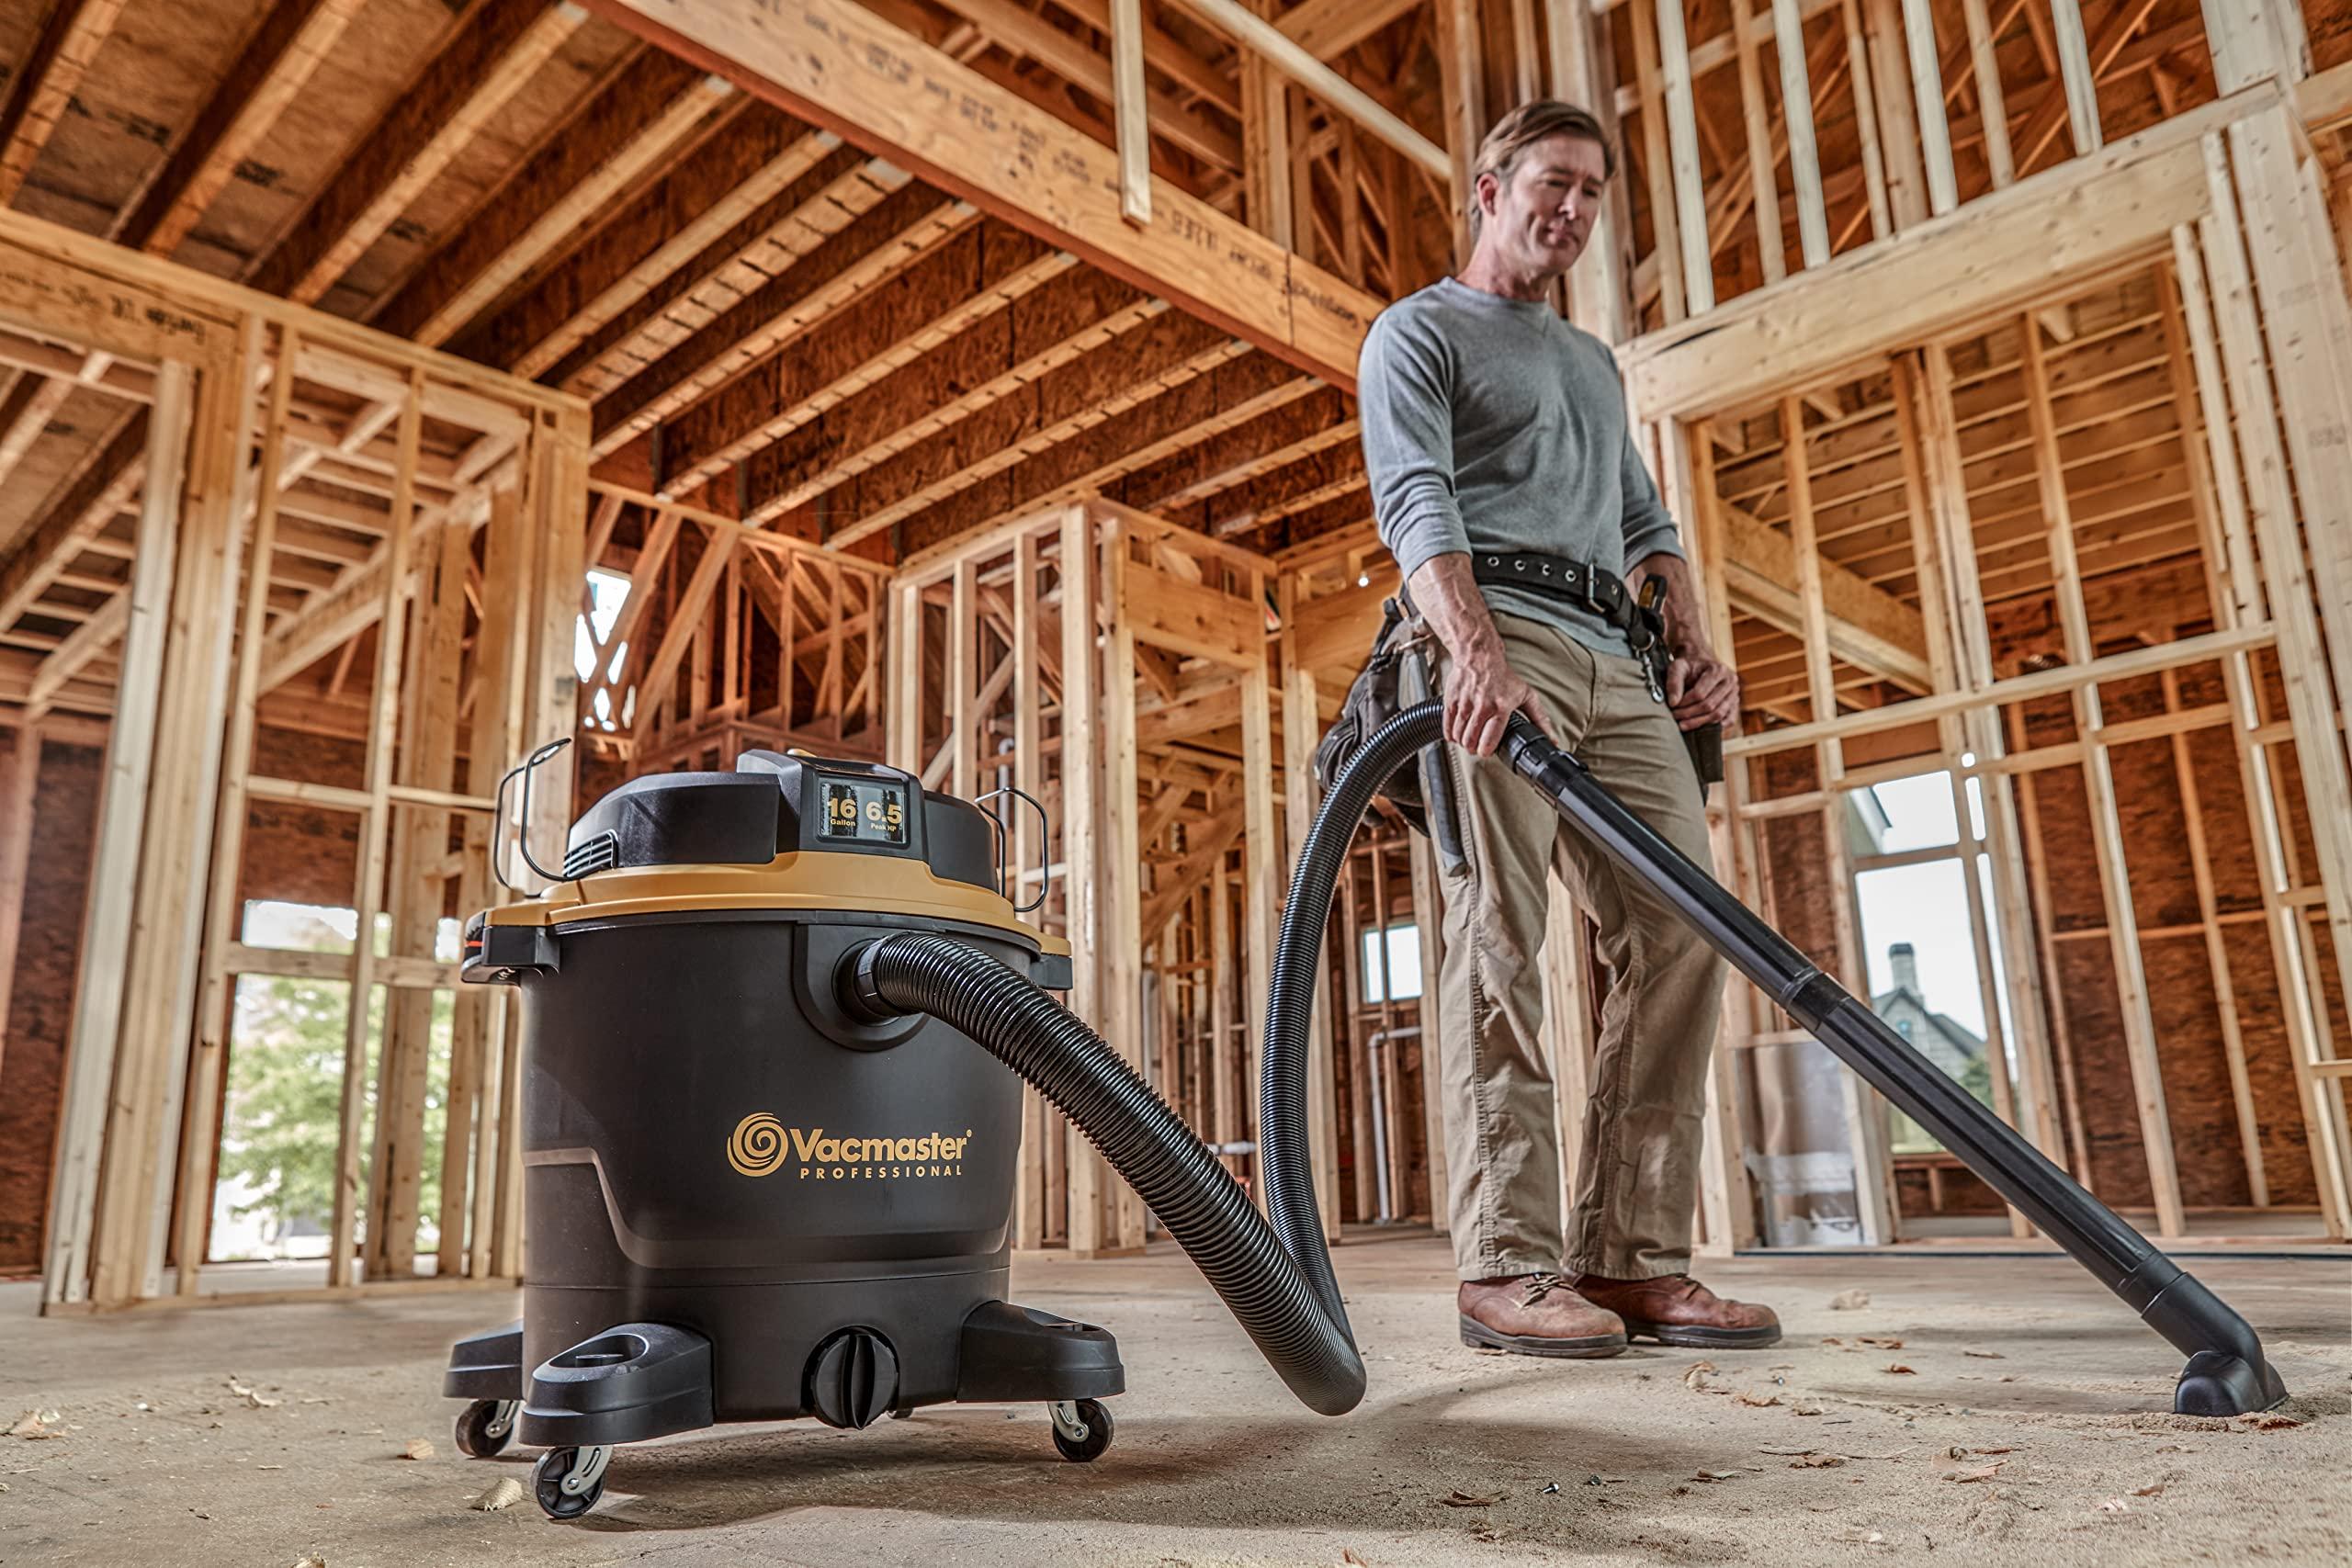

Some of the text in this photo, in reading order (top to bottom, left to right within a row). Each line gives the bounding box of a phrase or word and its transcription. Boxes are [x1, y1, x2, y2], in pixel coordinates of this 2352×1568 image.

[827, 797, 856, 818] 16
[866, 801, 902, 824] 6.5
[830, 818, 856, 827] Gallon
[871, 822, 887, 831] Peak
[789, 1128, 967, 1163] Vacmaster
[800, 1165, 962, 1179] PROFESSIONAL
